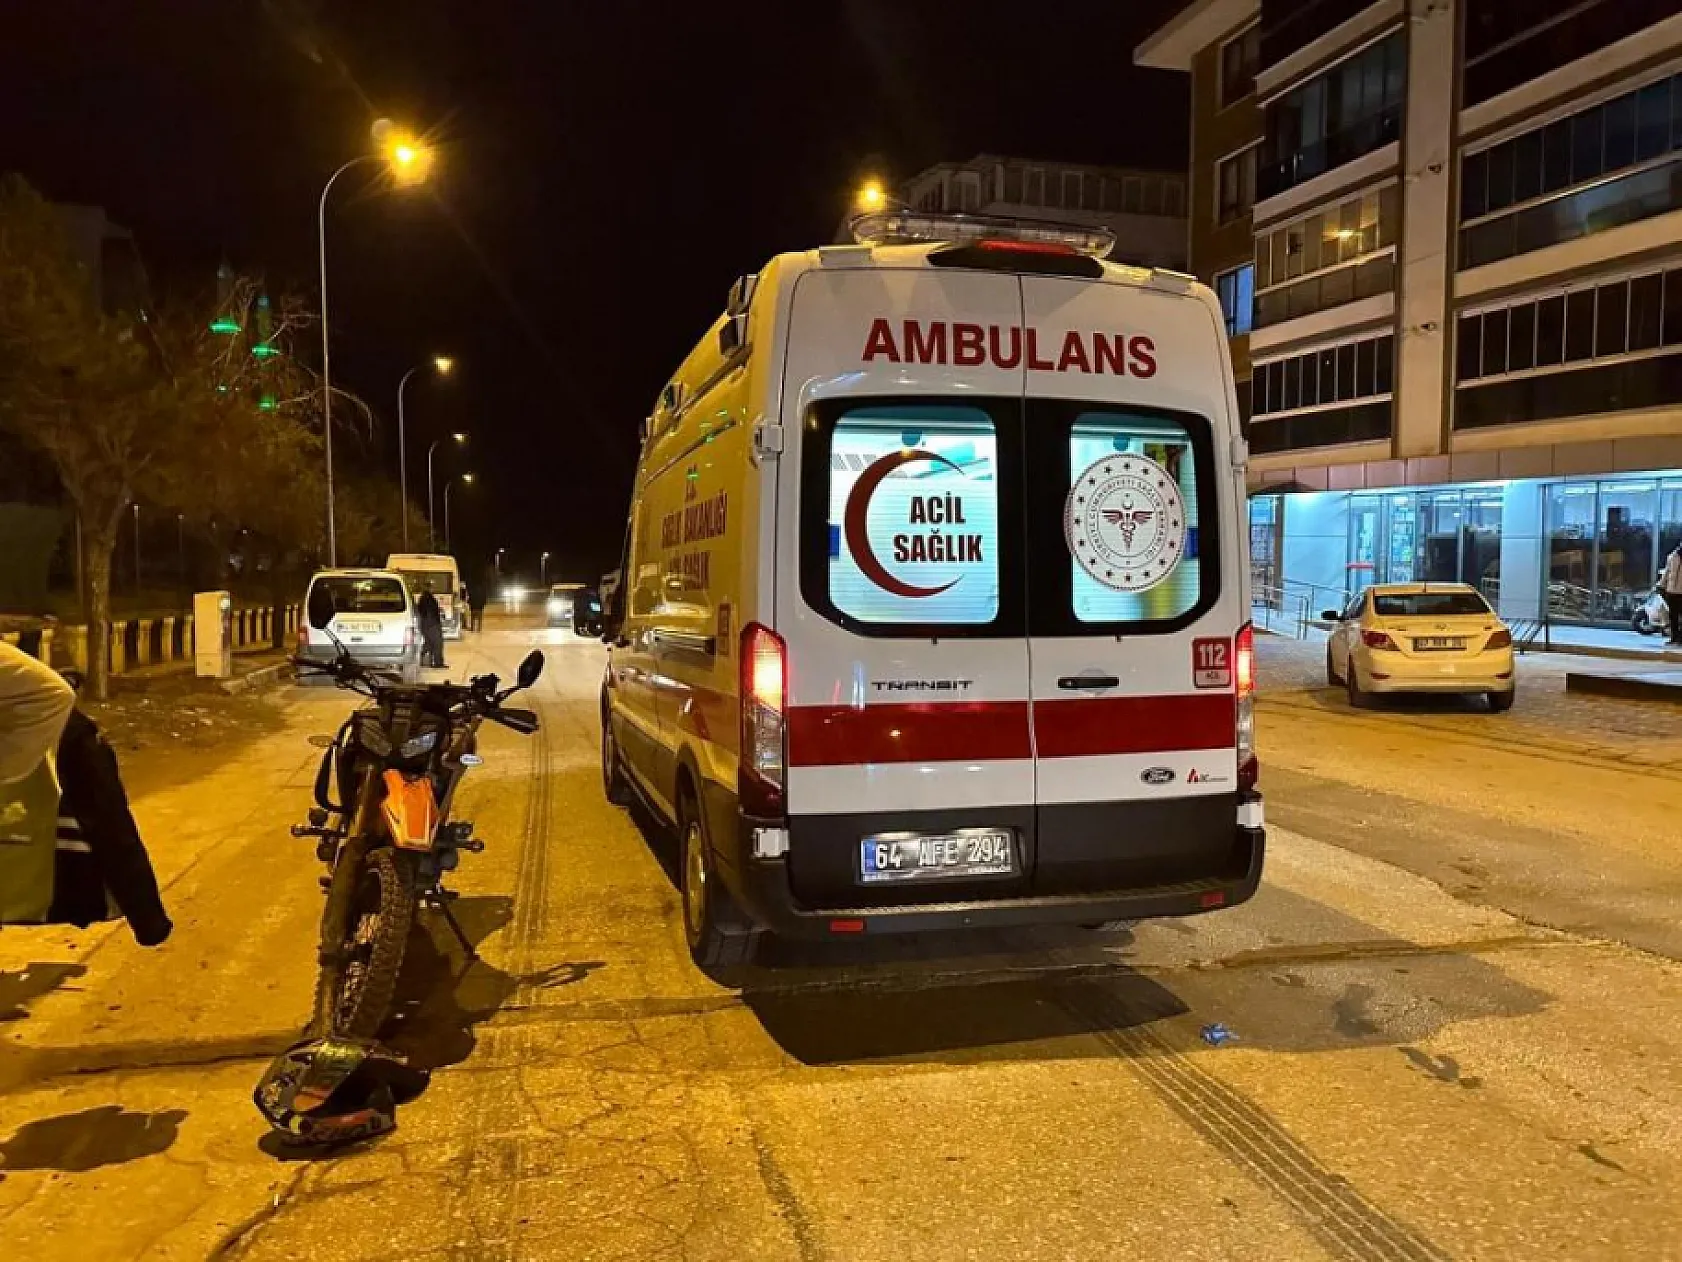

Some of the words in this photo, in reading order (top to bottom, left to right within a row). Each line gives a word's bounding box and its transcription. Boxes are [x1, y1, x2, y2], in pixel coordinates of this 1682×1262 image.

[862, 317, 1157, 379] AMBULANS
[910, 490, 966, 525] ACİL
[893, 528, 984, 564] SAĞLIK
[1199, 643, 1226, 667] 112
[871, 680, 974, 691] TRANSIT
[875, 843, 902, 869] 64
[919, 838, 960, 867] AFE
[967, 834, 1007, 865] 294
